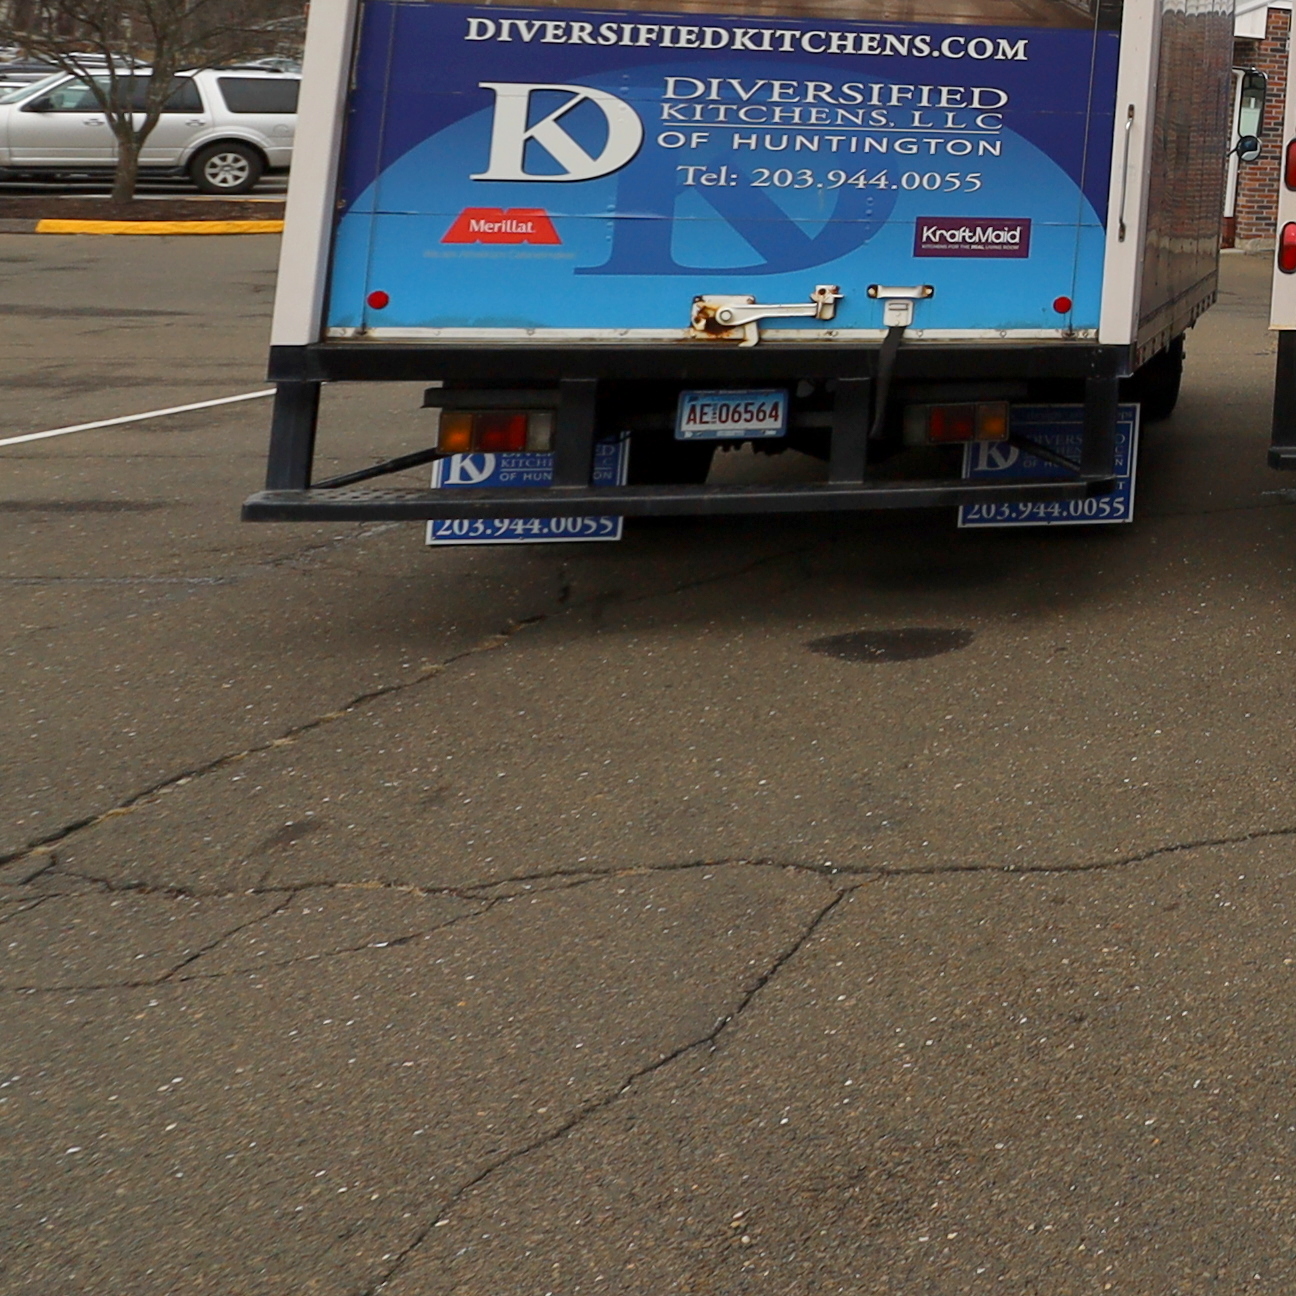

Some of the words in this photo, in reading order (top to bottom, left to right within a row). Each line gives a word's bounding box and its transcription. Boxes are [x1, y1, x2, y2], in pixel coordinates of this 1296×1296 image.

[464, 16, 1029, 63] DIVERSIFIEDKITCHENS.COM
[660, 75, 1010, 111] DIVERSIFIED
[656, 131, 709, 151] OF
[732, 133, 1003, 158] HUNTINGTON
[677, 164, 740, 189] Tel:
[749, 167, 985, 194] 203.944.0055
[469, 219, 535, 233] Merillat
[921, 225, 1021, 244] KraftMaid
[686, 402, 712, 425] AE
[717, 401, 780, 424] 06564
[499, 472, 515, 482] OF
[967, 496, 1126, 520] 203.944.0055
[436, 517, 614, 537] 203.944.0055
